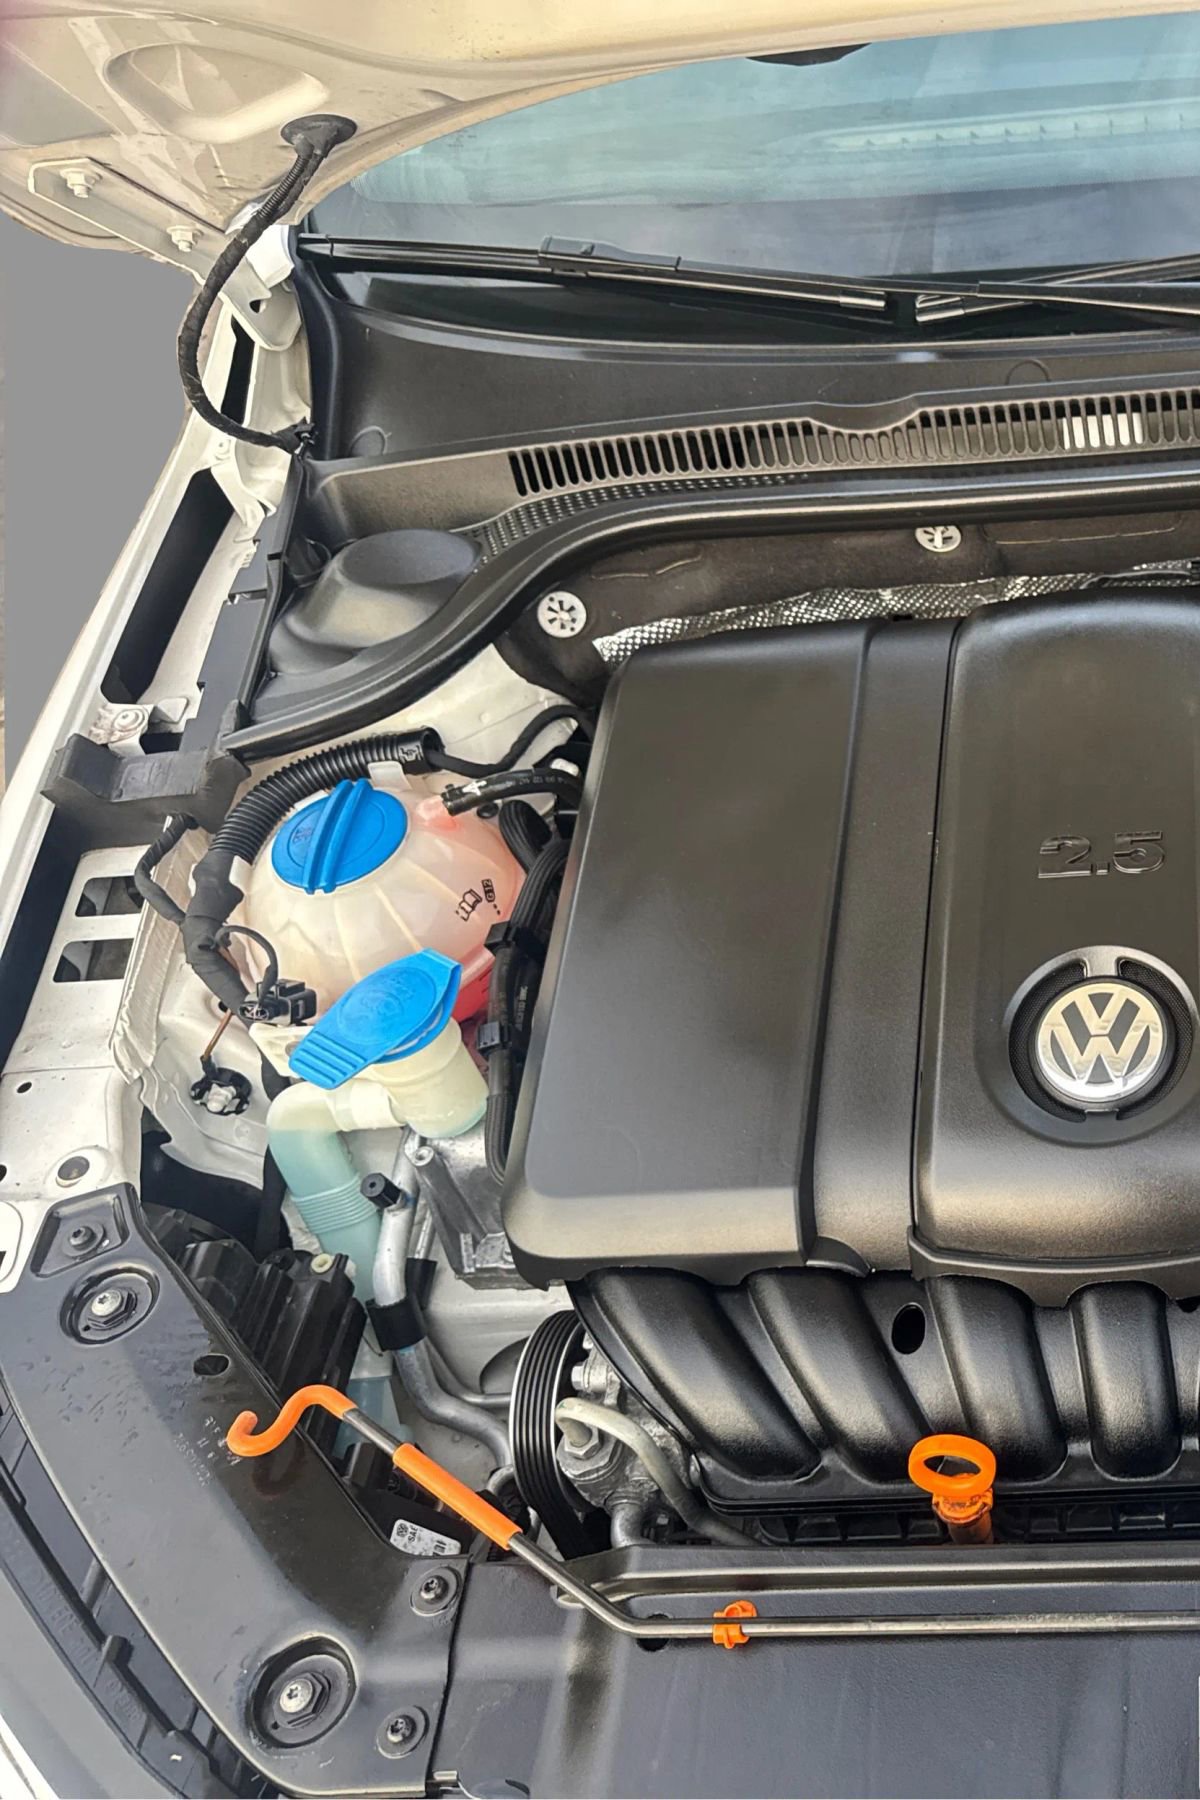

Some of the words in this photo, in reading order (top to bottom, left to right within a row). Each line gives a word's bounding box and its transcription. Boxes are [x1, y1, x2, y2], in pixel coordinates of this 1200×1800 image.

[1038, 831, 1166, 878] 2.5
[484, 880, 495, 901] G12
[1036, 983, 1163, 1098] VW
